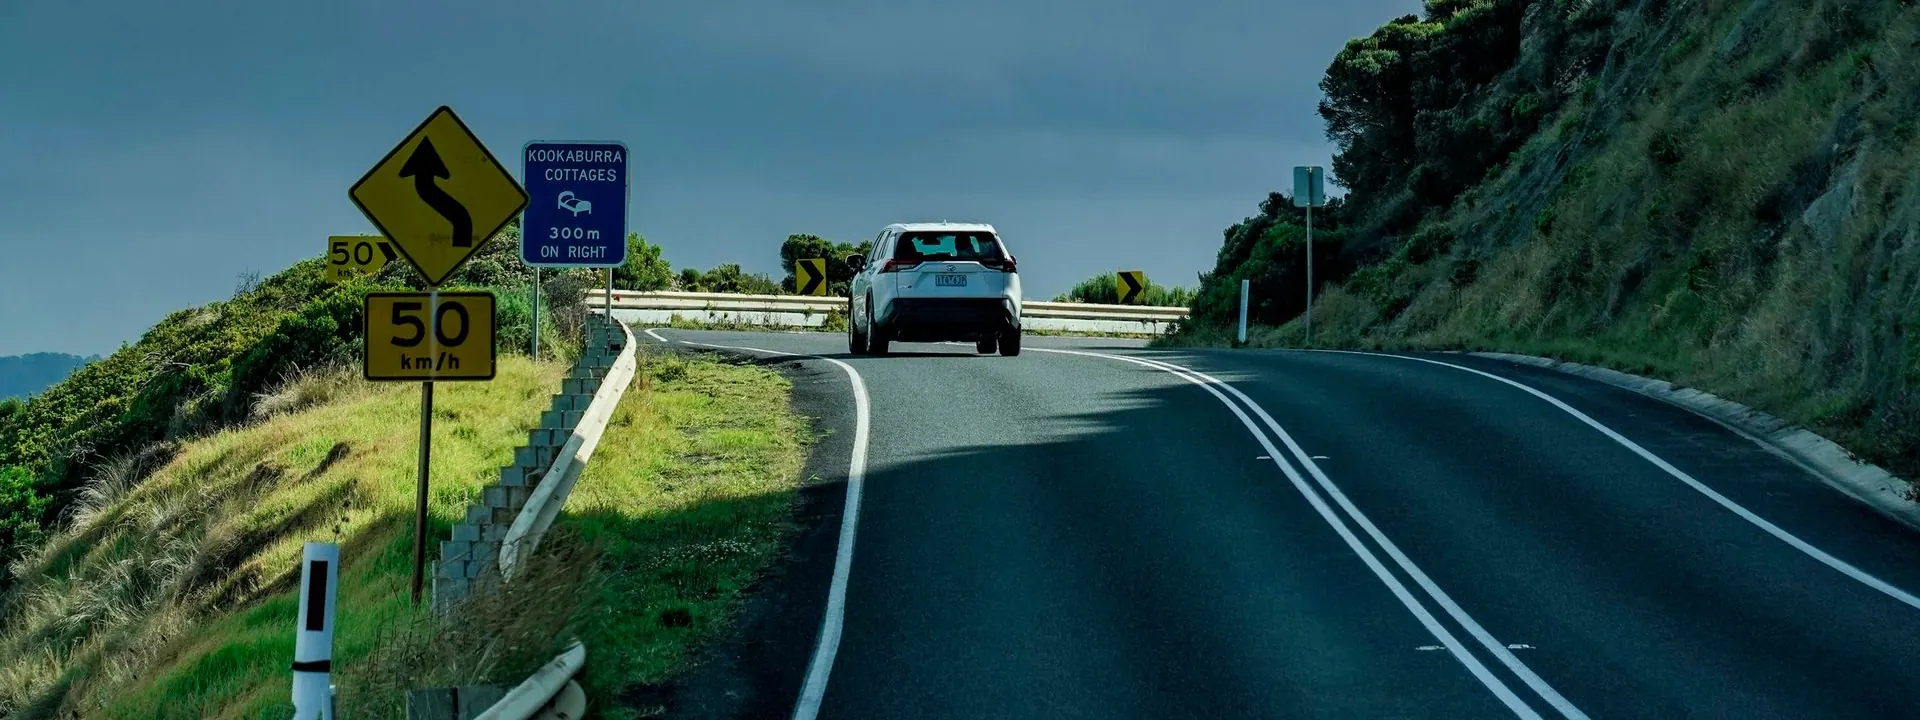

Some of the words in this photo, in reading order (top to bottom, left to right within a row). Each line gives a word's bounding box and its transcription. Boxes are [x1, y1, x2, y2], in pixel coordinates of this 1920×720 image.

[528, 149, 623, 163] KOOKABURRA
[545, 168, 617, 182] COTTAGES
[331, 241, 374, 266] 50
[541, 245, 559, 258] ON
[568, 245, 607, 259] RIGHT
[390, 301, 470, 348] 50
[401, 352, 460, 371] km/h
